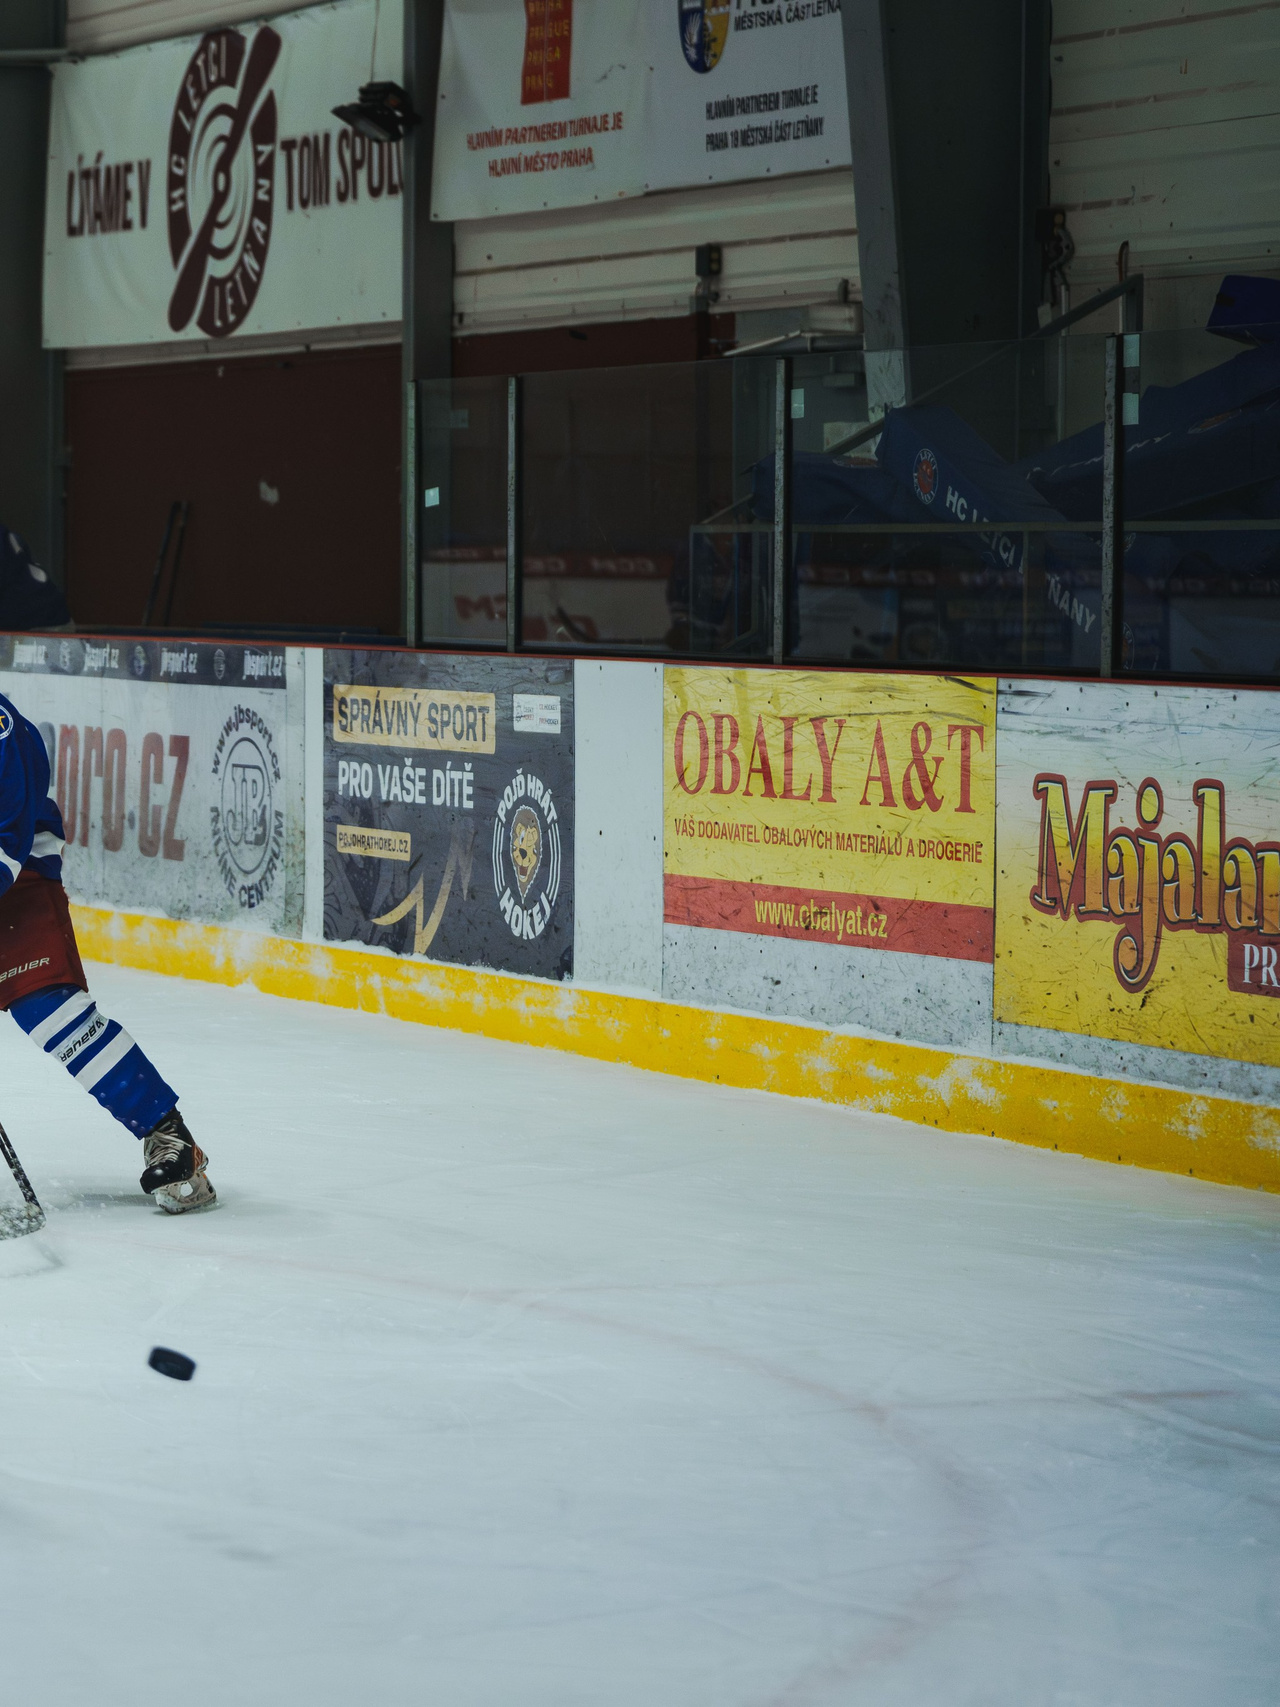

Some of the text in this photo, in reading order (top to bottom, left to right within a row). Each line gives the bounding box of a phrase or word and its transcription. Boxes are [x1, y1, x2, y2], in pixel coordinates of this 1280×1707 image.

[505, 120, 568, 146] PARTNEREM
[569, 113, 609, 138] TURNAJE
[611, 111, 623, 131] JE
[706, 131, 729, 152] PRAHA
[280, 131, 330, 215] TOM
[488, 146, 594, 178] HLAVNÍ MĚSTO PRAHA
[138, 158, 152, 231] V
[945, 485, 968, 523] HC
[337, 690, 490, 742] SPRÁVNÝ SPORT
[338, 758, 474, 809] PRO VAŠE DÍTĚ
[674, 710, 985, 814] OBALY A&T
[674, 814, 983, 864] VÁŠ DODAVATEL OBALOVÝCH MATERIÁLŮ A DROGERIE
[499, 887, 552, 940] HOKEJ
[754, 899, 888, 941] www.obalyat.cz
